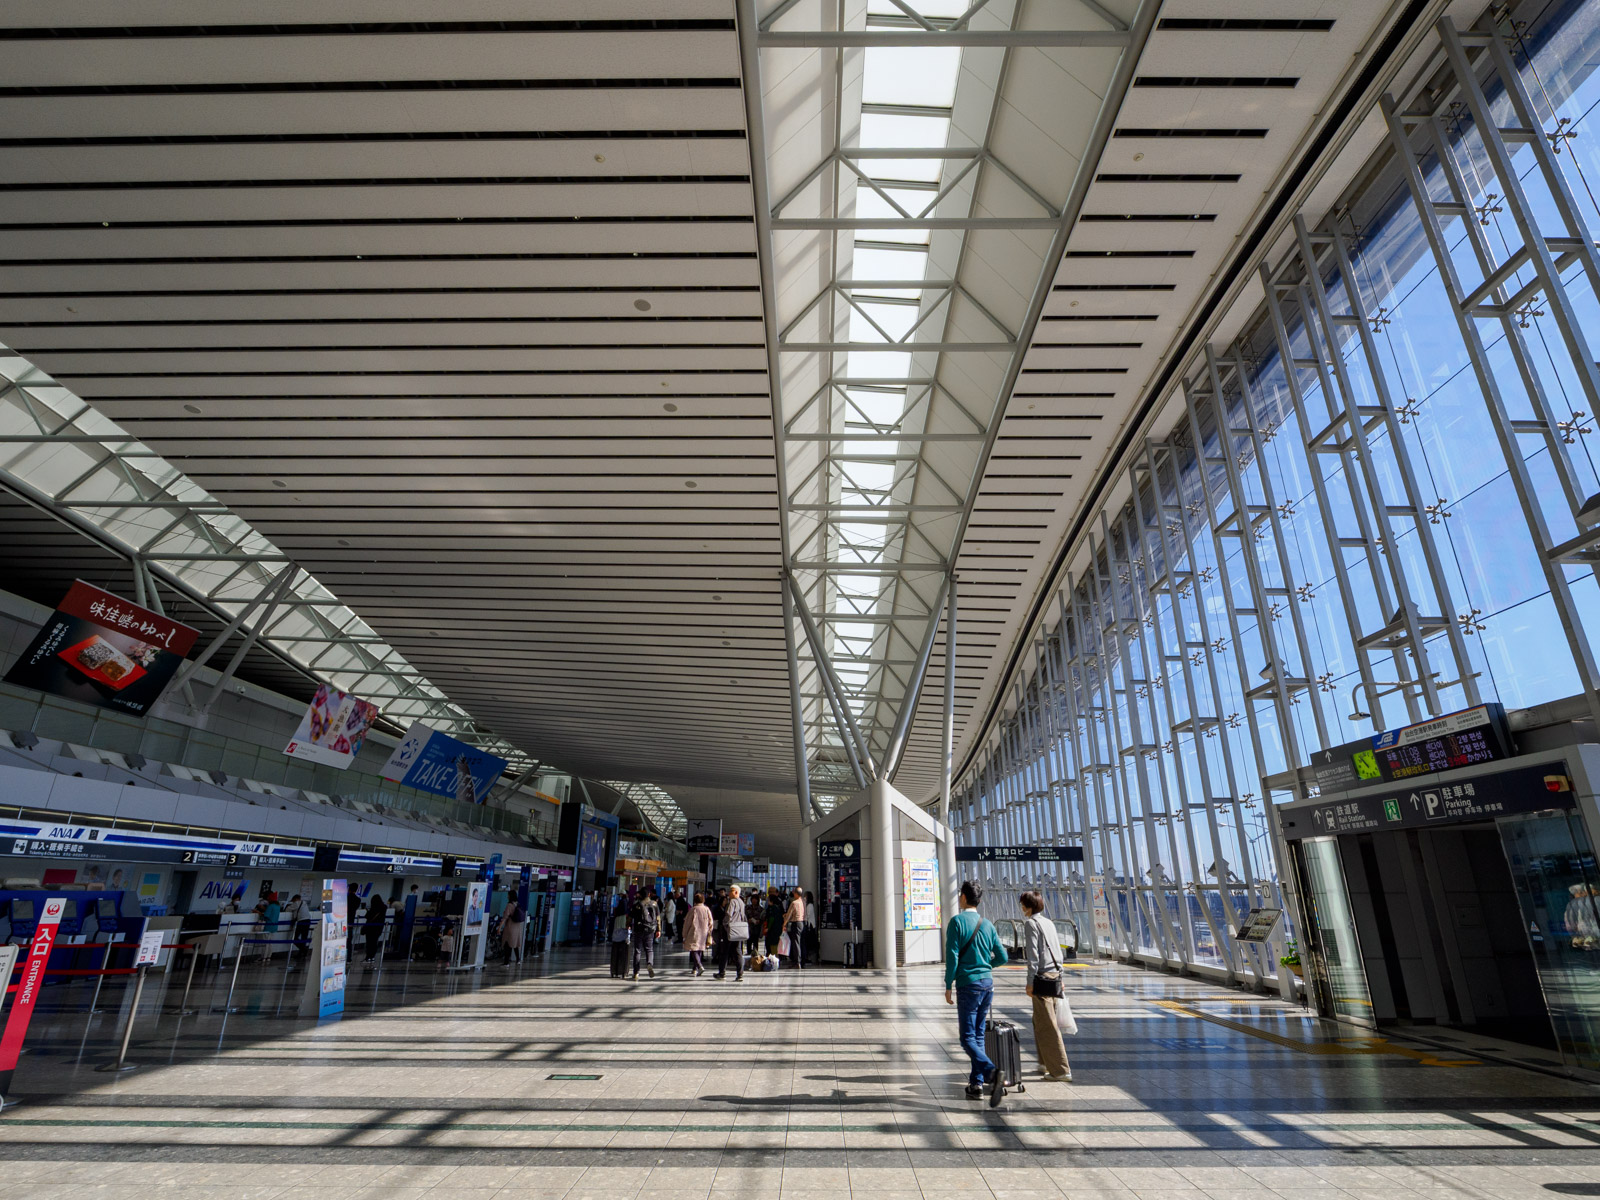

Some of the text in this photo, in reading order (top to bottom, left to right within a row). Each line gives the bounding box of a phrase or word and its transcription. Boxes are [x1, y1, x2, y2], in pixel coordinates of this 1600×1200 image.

[411, 758, 453, 793] TAKE
[1442, 783, 1475, 800] 駐車場
[1336, 803, 1360, 816] 鉄道駅
[1424, 793, 1439, 815] P
[1445, 799, 1472, 809] Parking
[1338, 814, 1366, 823] Rail Station
[49, 827, 73, 839] ANA
[30, 841, 84, 853] 購入・搭乗手続き
[240, 844, 256, 852] ANA
[822, 845, 827, 856] 2
[994, 848, 1031, 856] 到着ロビー
[183, 852, 191, 862] 2
[229, 855, 236, 864] 3
[200, 881, 234, 899] ANA
[32, 928, 52, 956] 入口
[20, 960, 41, 1004] ENTRANCE
